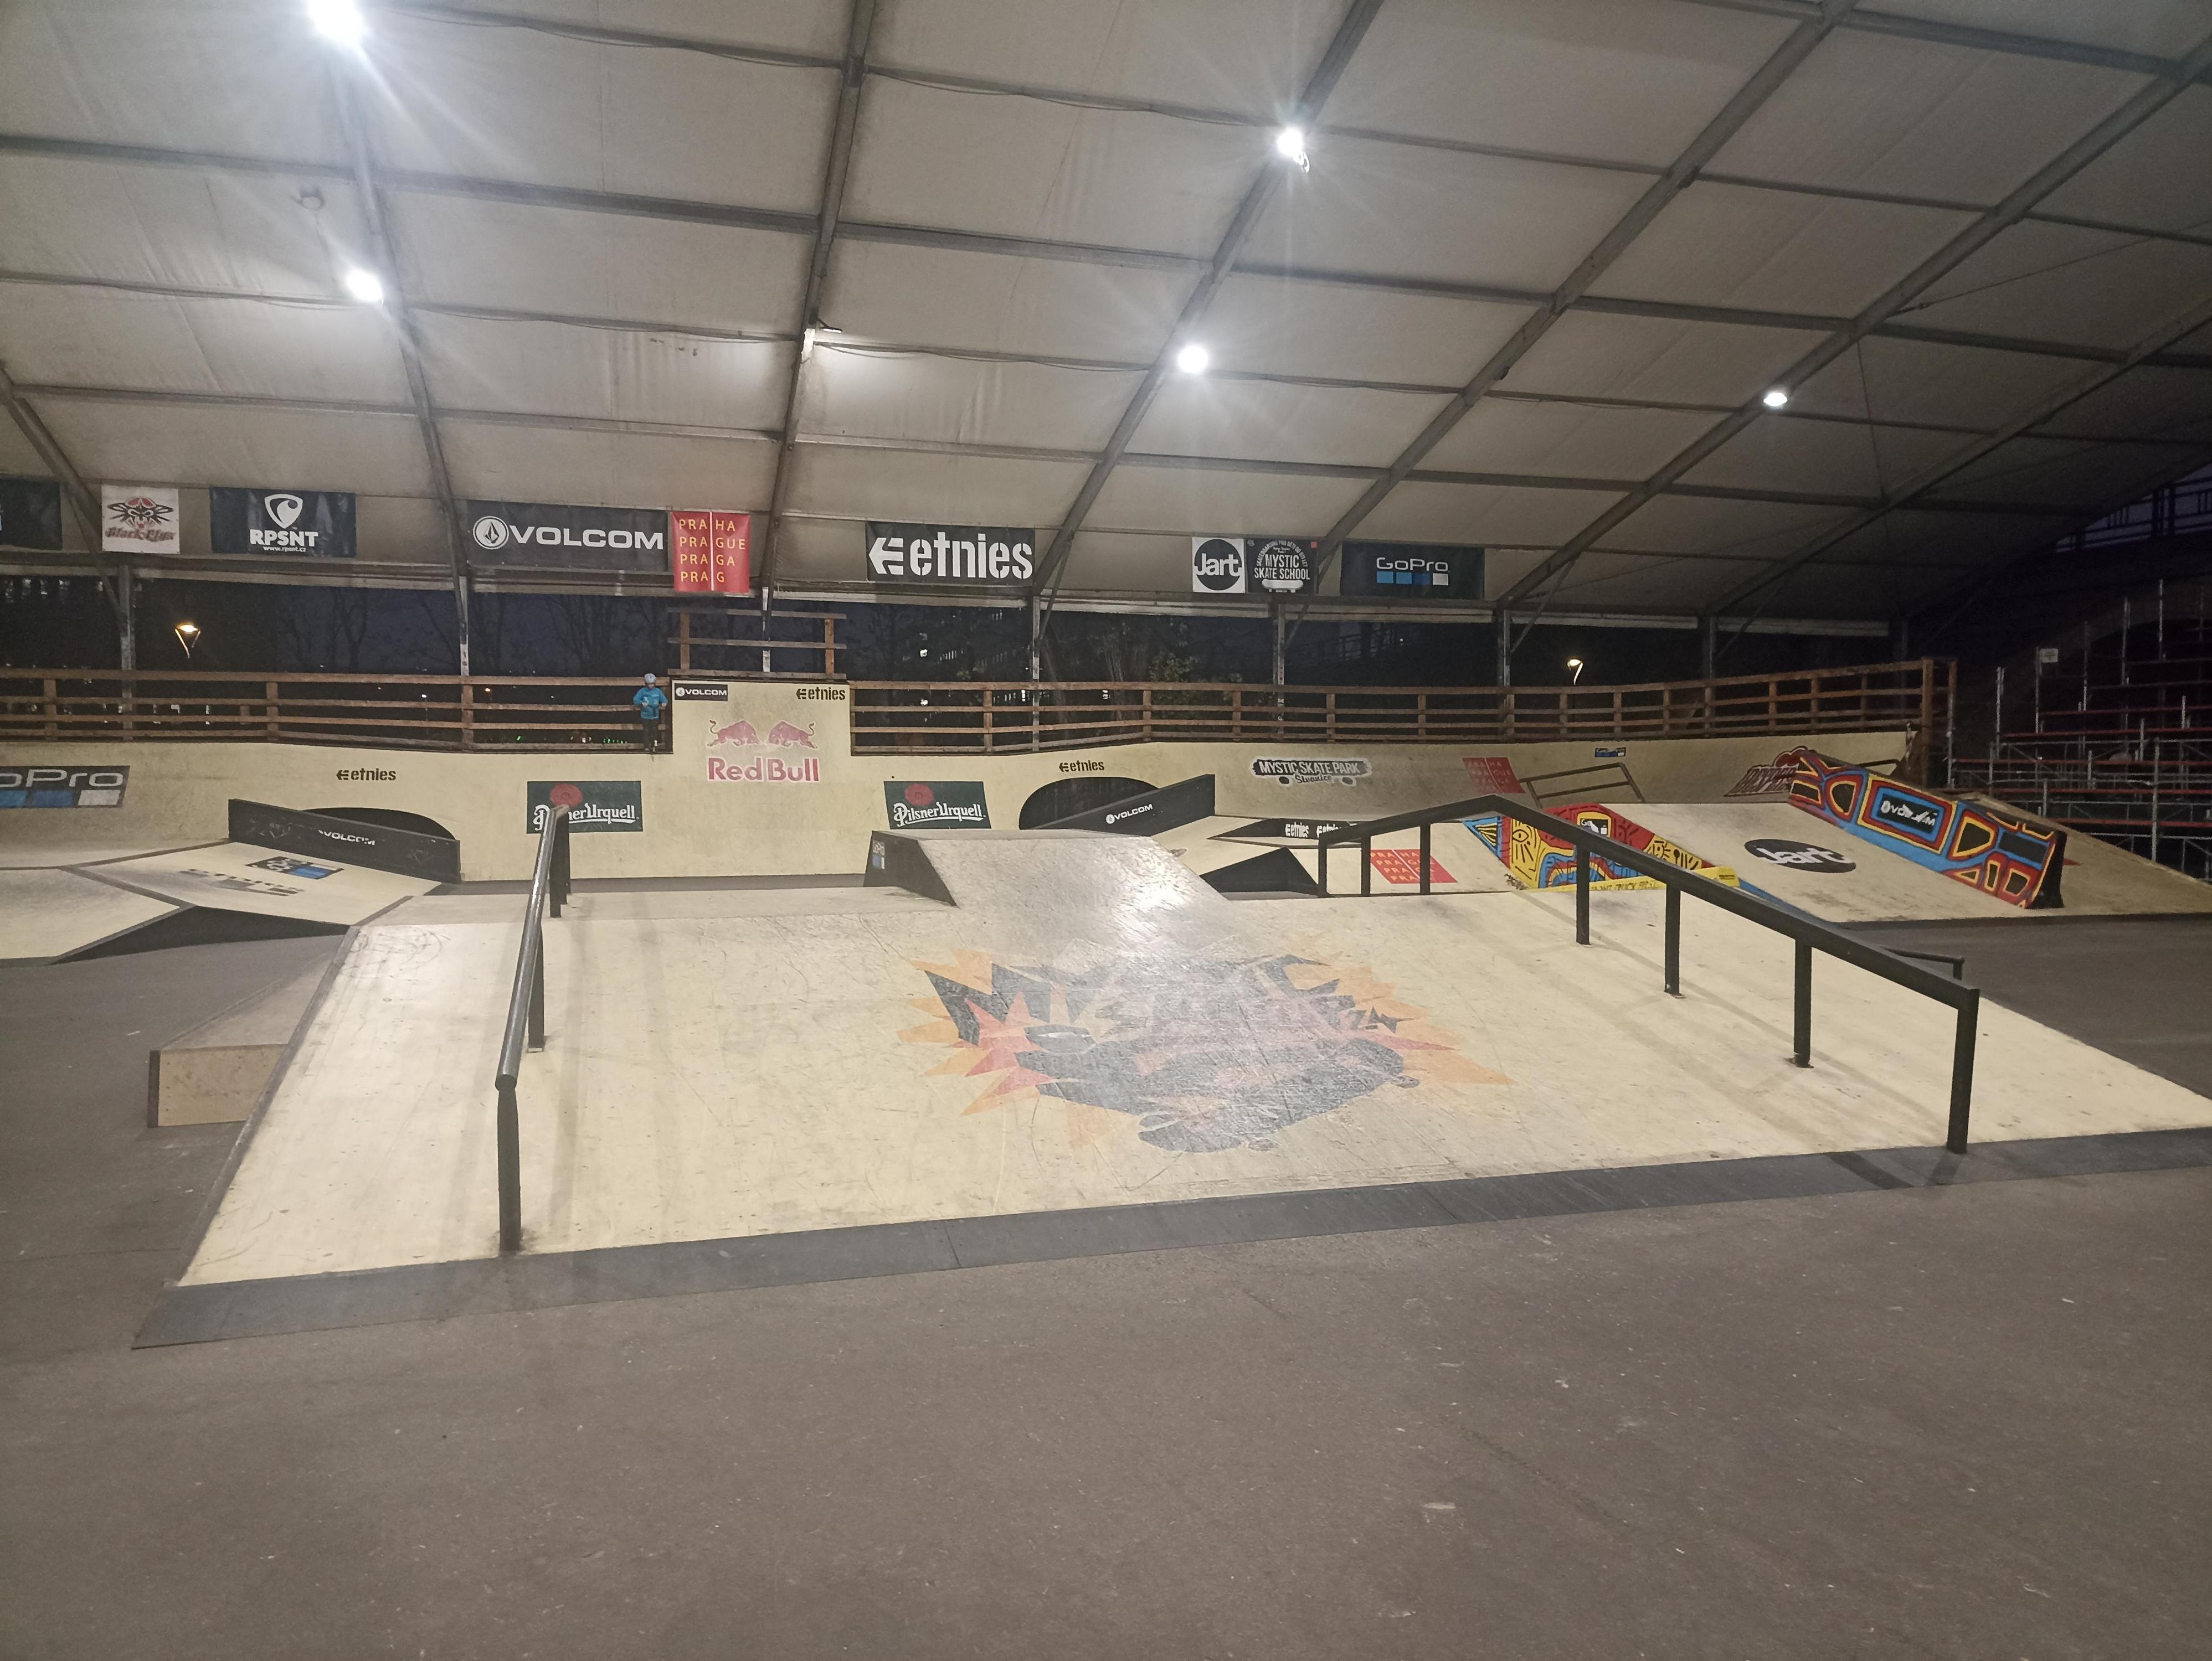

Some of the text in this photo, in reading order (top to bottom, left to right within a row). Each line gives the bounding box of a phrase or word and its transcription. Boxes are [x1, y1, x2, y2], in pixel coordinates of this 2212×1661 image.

[679, 519, 735, 532] PRA HA
[250, 529, 318, 547] RPSNT
[510, 525, 663, 550] VOLCOM
[680, 537, 746, 550] PRA GUE
[680, 554, 735, 566] PRA GA
[910, 532, 1033, 579] etnies
[1265, 554, 1299, 568] MYSTIC
[1195, 553, 1242, 577] Jart
[1376, 557, 1449, 571] GoPro
[681, 571, 708, 582] PRA
[1254, 568, 1310, 580] SKATE SCHOOL
[808, 687, 846, 700] etnies
[708, 757, 819, 782] Red Bull
[1070, 760, 1105, 772] etnies
[1258, 761, 1361, 774] MYSTIC SKATE PARK
[0, 768, 124, 787] oPro
[351, 768, 397, 781] etnies
[584, 803, 635, 824] Urquell
[893, 801, 982, 827] Pilsner Urquell
[1114, 803, 1153, 820] VOLCOM
[1756, 848, 1854, 864] Jart
